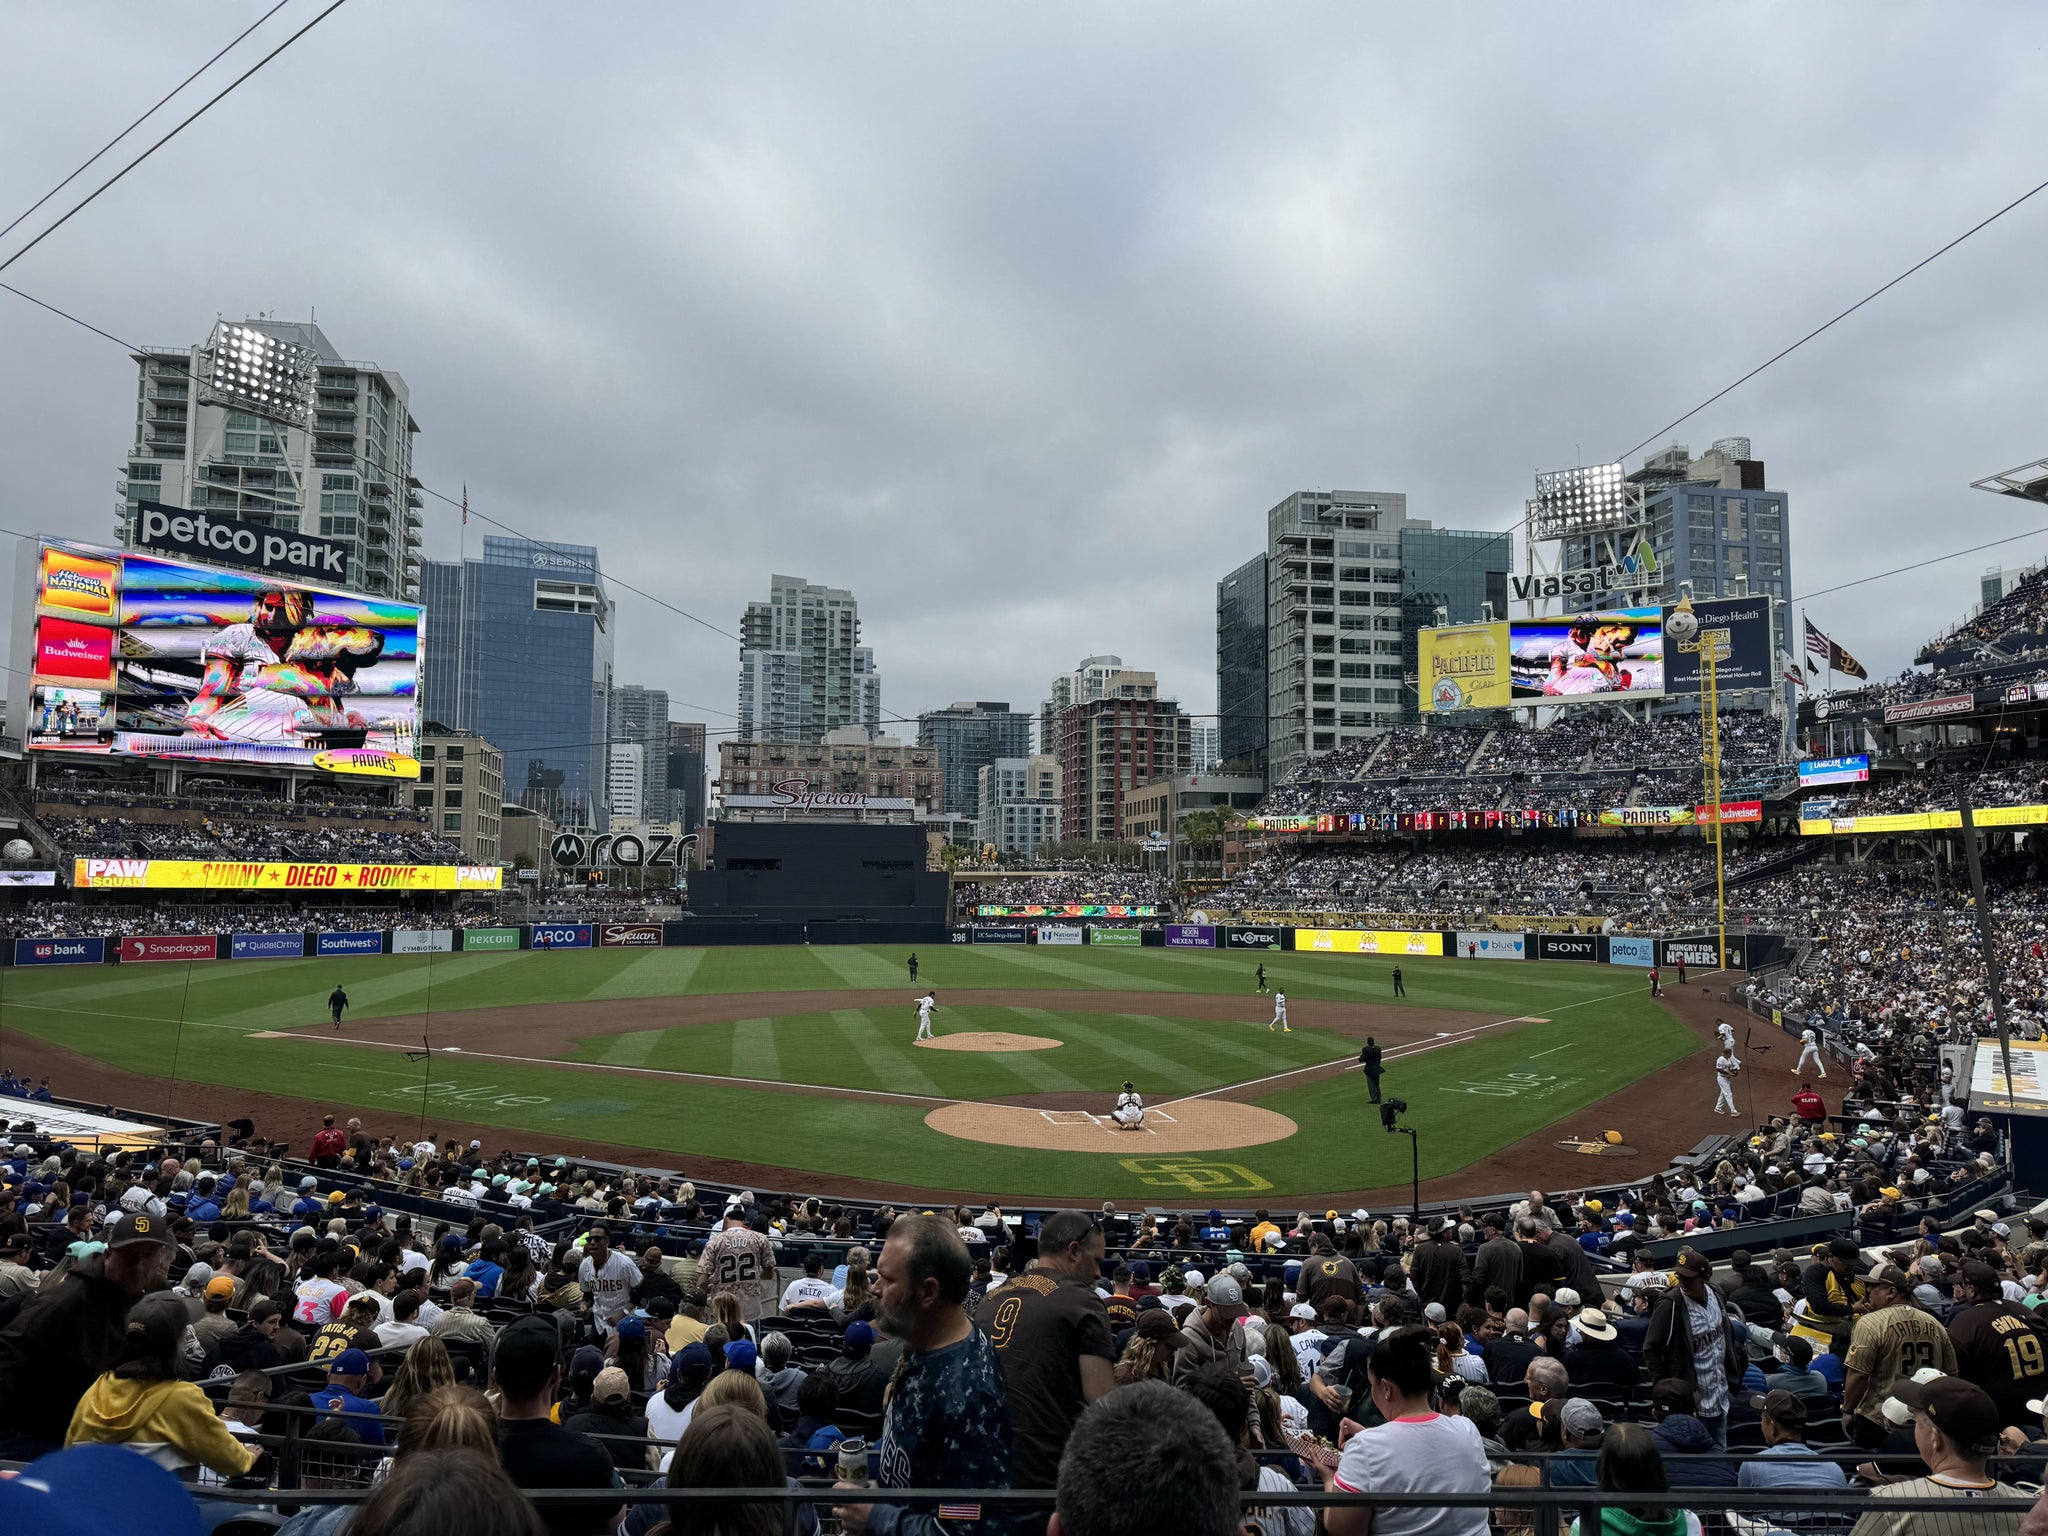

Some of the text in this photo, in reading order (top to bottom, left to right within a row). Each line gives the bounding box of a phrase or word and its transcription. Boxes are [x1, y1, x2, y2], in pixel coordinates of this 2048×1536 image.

[142, 510, 344, 573] petco park
[549, 557, 593, 569] SEMPRA
[57, 570, 101, 586] Hebrew
[1512, 566, 1613, 599] Viasat
[49, 576, 109, 598] NATIONAL
[1705, 614, 1729, 624] Diego
[1731, 611, 1759, 620] Health
[44, 646, 104, 660] Budweiser
[1432, 654, 1495, 677] PACIFICO
[1830, 699, 1852, 711] MRC
[1886, 701, 1971, 721] Tarantino SAUSAGES
[353, 754, 396, 772] PADRES
[772, 778, 869, 814] Sycuan
[1264, 818, 1299, 830] PADRES
[1623, 810, 1671, 825] PADRES
[590, 833, 699, 867] razr
[89, 860, 148, 877] PAW
[202, 864, 417, 887] SUNNY DIEGO ROOKIE
[457, 866, 497, 882] PAW
[92, 877, 145, 887] SQUAD
[534, 930, 576, 943] ARCO
[605, 926, 657, 945] Sycuan
[952, 933, 967, 942] 396
[1232, 932, 1274, 944] EVOTEK
[36, 944, 85, 956] us bank
[150, 944, 211, 955] Snapdragon
[249, 940, 301, 951] QuidelOrtho
[322, 938, 372, 948] Southwest
[1314, 940, 1332, 948] PAW
[1360, 942, 1377, 950] PAW
[1407, 944, 1426, 952] PAW
[1492, 941, 1513, 949] blue
[1547, 942, 1592, 952] SONY
[1669, 943, 1713, 952] HUNGRY FOR
[1612, 944, 1637, 957] petco
[134, 1216, 151, 1233] SD
[726, 1238, 748, 1249] SOTO
[719, 1253, 756, 1283] 22
[1642, 1277, 1660, 1286] TATIS
[798, 1288, 822, 1297] MILLER
[991, 1297, 1022, 1348] 9
[1890, 1319, 1940, 1339] TATIS JR.
[321, 1323, 358, 1340] TATIS JR.
[309, 1335, 348, 1372] 23
[1901, 1340, 1933, 1377] 23
[2003, 1334, 2046, 1380] 19
